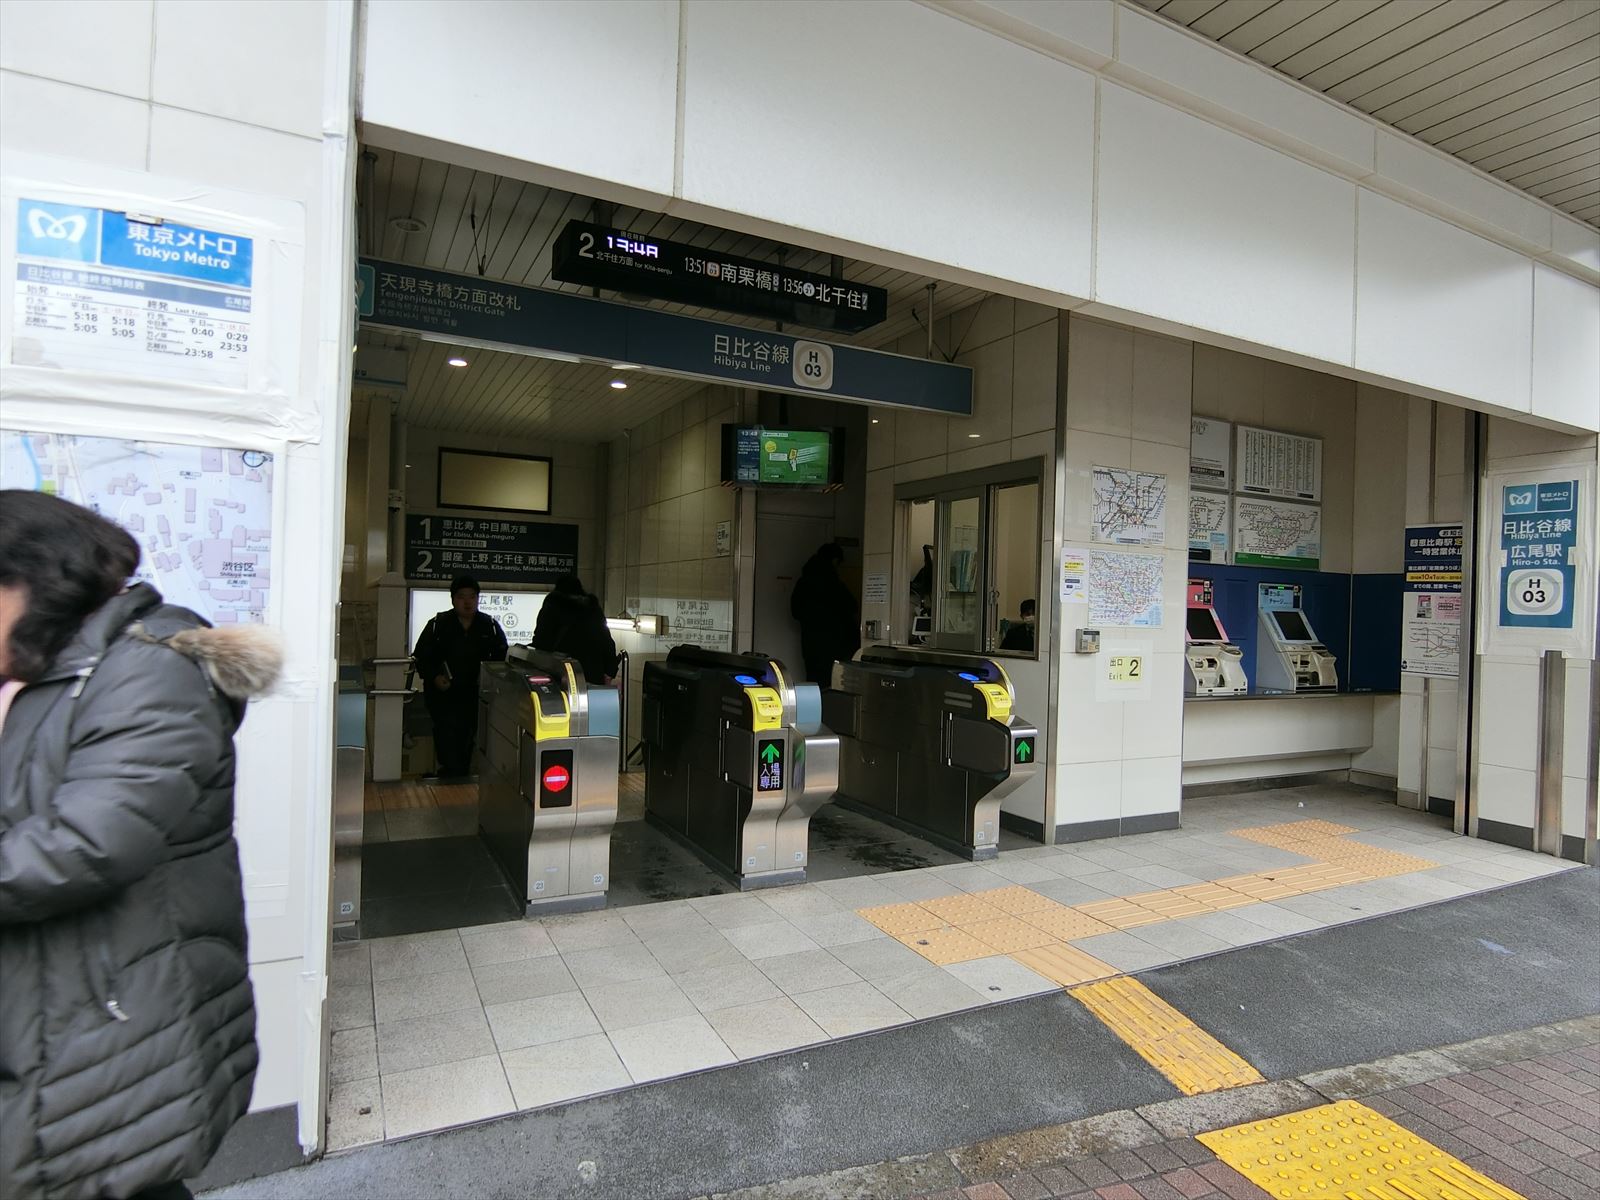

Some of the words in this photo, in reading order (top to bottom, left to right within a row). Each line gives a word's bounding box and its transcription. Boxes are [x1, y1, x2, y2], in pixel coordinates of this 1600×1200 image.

[128, 224, 237, 256] 東京メトロ
[578, 232, 594, 259] 2
[134, 243, 181, 265] Tokyo
[184, 250, 230, 270] Metro
[596, 251, 634, 267] 北千住方面
[684, 257, 706, 275] 13:51
[720, 263, 772, 291] 南栗橋
[381, 273, 521, 311] 天現寺橋方面改札
[783, 277, 803, 295] 13:56
[381, 288, 447, 308] Tengenjibashi
[449, 300, 482, 313] District
[484, 306, 506, 317] Gate
[816, 283, 862, 309] 北千住
[74, 311, 98, 323] 5:18
[112, 316, 135, 327] 5:18
[74, 323, 98, 334] 5:05
[112, 327, 135, 338] 5:05
[191, 327, 214, 338] 0:40
[226, 331, 248, 342] 0:29
[184, 347, 214, 359] 23:58
[220, 341, 248, 353] 23:53
[714, 334, 790, 365] 日比谷線
[809, 351, 818, 363] H
[713, 355, 747, 370] Hibiya
[750, 360, 771, 373] Line
[804, 363, 822, 378] 03
[419, 518, 432, 540] 1
[1503, 518, 1572, 535] 日比谷線
[1511, 532, 1539, 541] Hibiya
[1510, 543, 1562, 559] 広尾駅
[416, 550, 433, 573] 2
[467, 552, 489, 564] 上野
[493, 553, 524, 565] 北千住
[222, 560, 254, 572] 渋谷区
[1528, 579, 1541, 588] H
[1522, 590, 1546, 603] 03
[1109, 658, 1123, 667] 出口
[1128, 659, 1139, 677] 2
[1108, 672, 1123, 680] Exit
[760, 762, 780, 776] 入場
[760, 776, 780, 789] 専用
[535, 882, 544, 890] 23
[342, 904, 351, 912] 23
